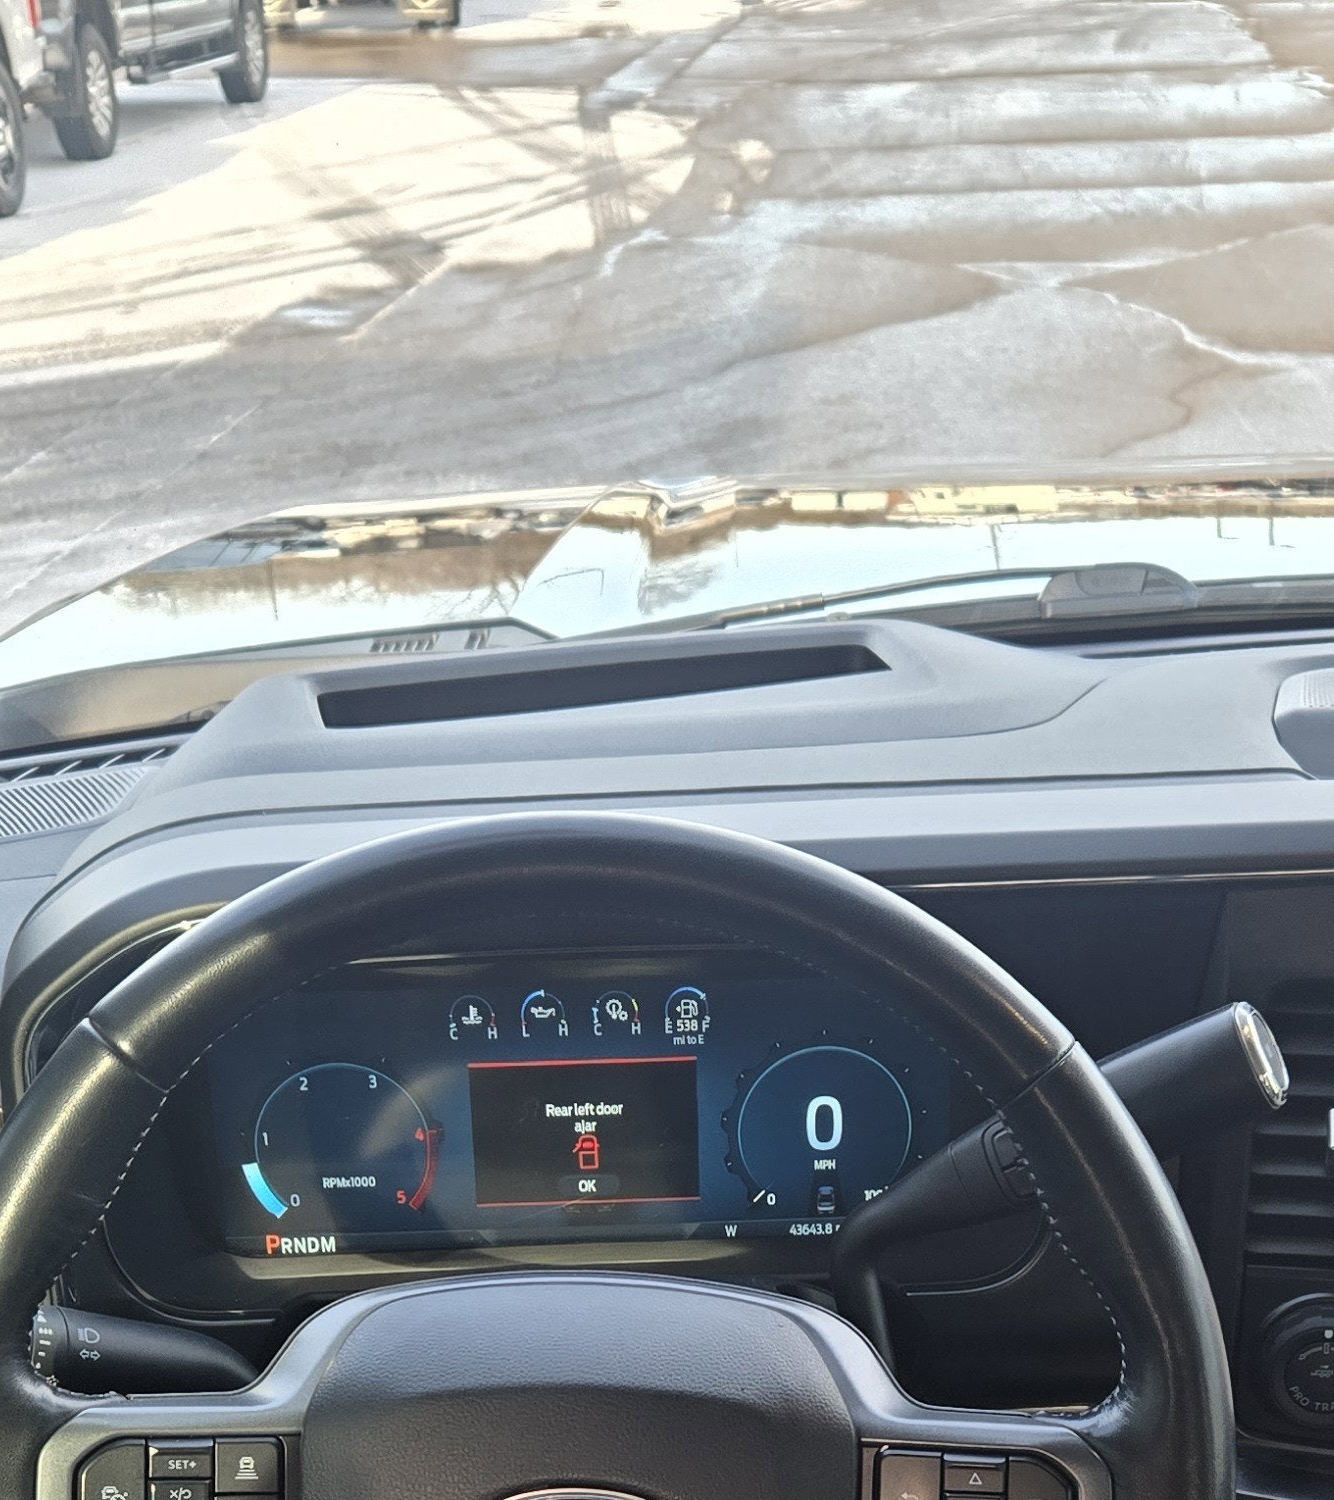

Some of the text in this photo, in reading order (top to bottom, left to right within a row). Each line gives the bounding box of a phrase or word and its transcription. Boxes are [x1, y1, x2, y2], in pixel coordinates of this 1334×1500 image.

[522, 1025, 530, 1037] L
[559, 1023, 568, 1036] H
[594, 1023, 602, 1036] C
[632, 1022, 641, 1035] H
[676, 1019, 698, 1032] 538
[702, 1020, 710, 1033] F
[449, 1028, 458, 1040] C
[488, 1027, 498, 1039] H
[673, 1034, 705, 1045] mi to E
[299, 1077, 308, 1091] 2
[369, 1074, 377, 1088] 3
[545, 1101, 623, 1117] Rear left door
[574, 1120, 597, 1134] ajar
[806, 1095, 843, 1150] 0
[262, 1131, 268, 1146] 1
[814, 1159, 835, 1170] MPH
[322, 1176, 376, 1189] RPMx1000
[578, 1179, 597, 1192] OK
[290, 1194, 300, 1206] 0
[396, 1190, 406, 1204] 5
[767, 1194, 776, 1205] 0
[725, 1225, 738, 1237] W
[789, 1223, 833, 1236] 43643.8
[1289, 1386, 1310, 1407] PRO
[168, 1459, 197, 1470] SET+
